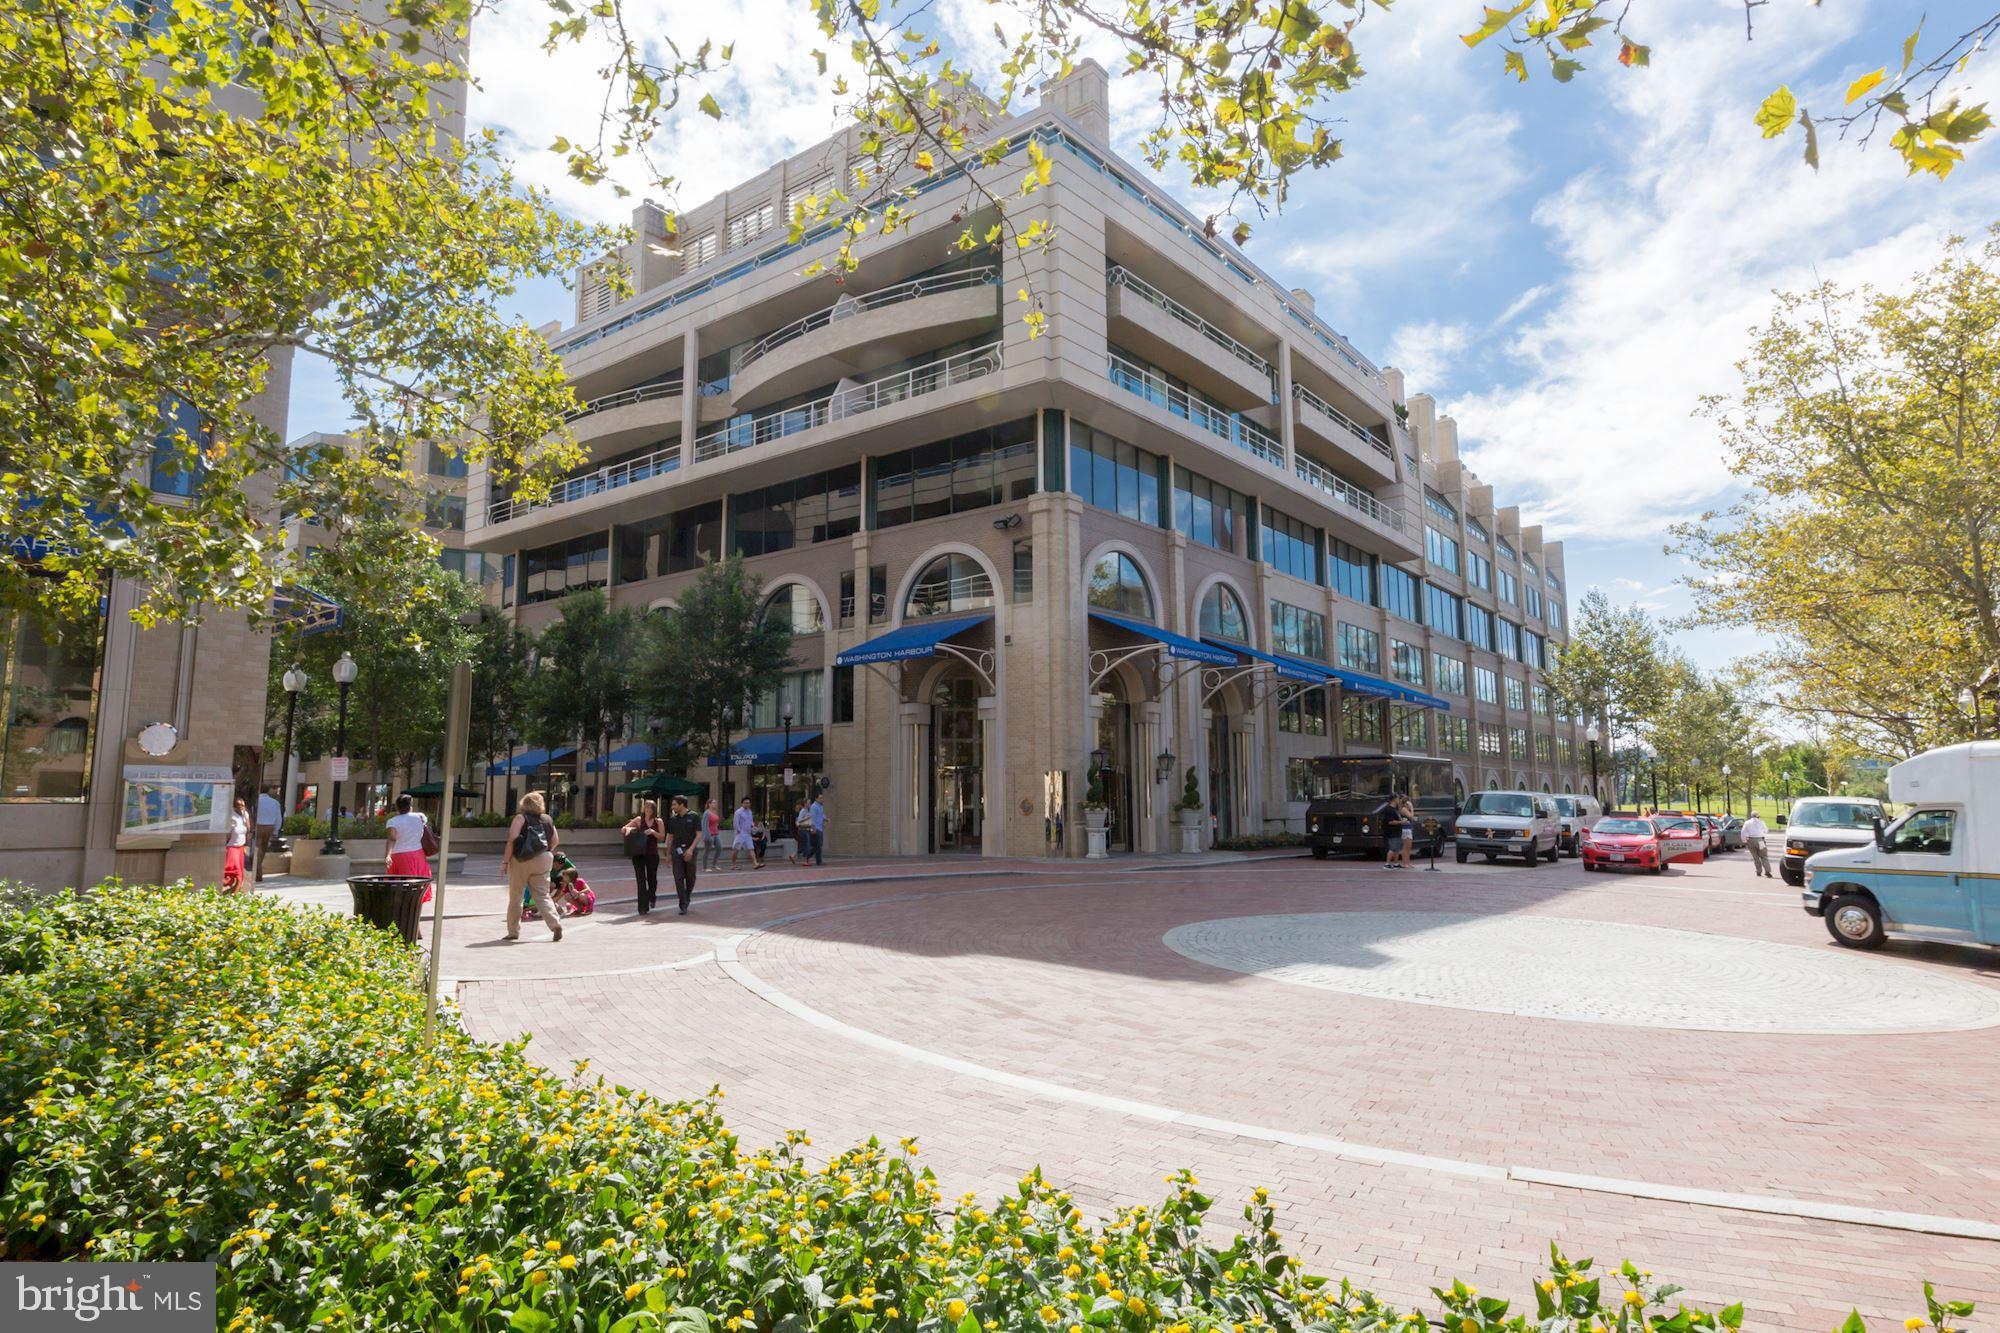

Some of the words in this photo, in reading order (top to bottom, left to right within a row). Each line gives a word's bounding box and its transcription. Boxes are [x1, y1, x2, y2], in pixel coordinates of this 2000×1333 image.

[843, 652, 892, 663] WASHINGTON
[894, 646, 933, 657] HARBOUR
[1176, 647, 1211, 659] WASHINGTON
